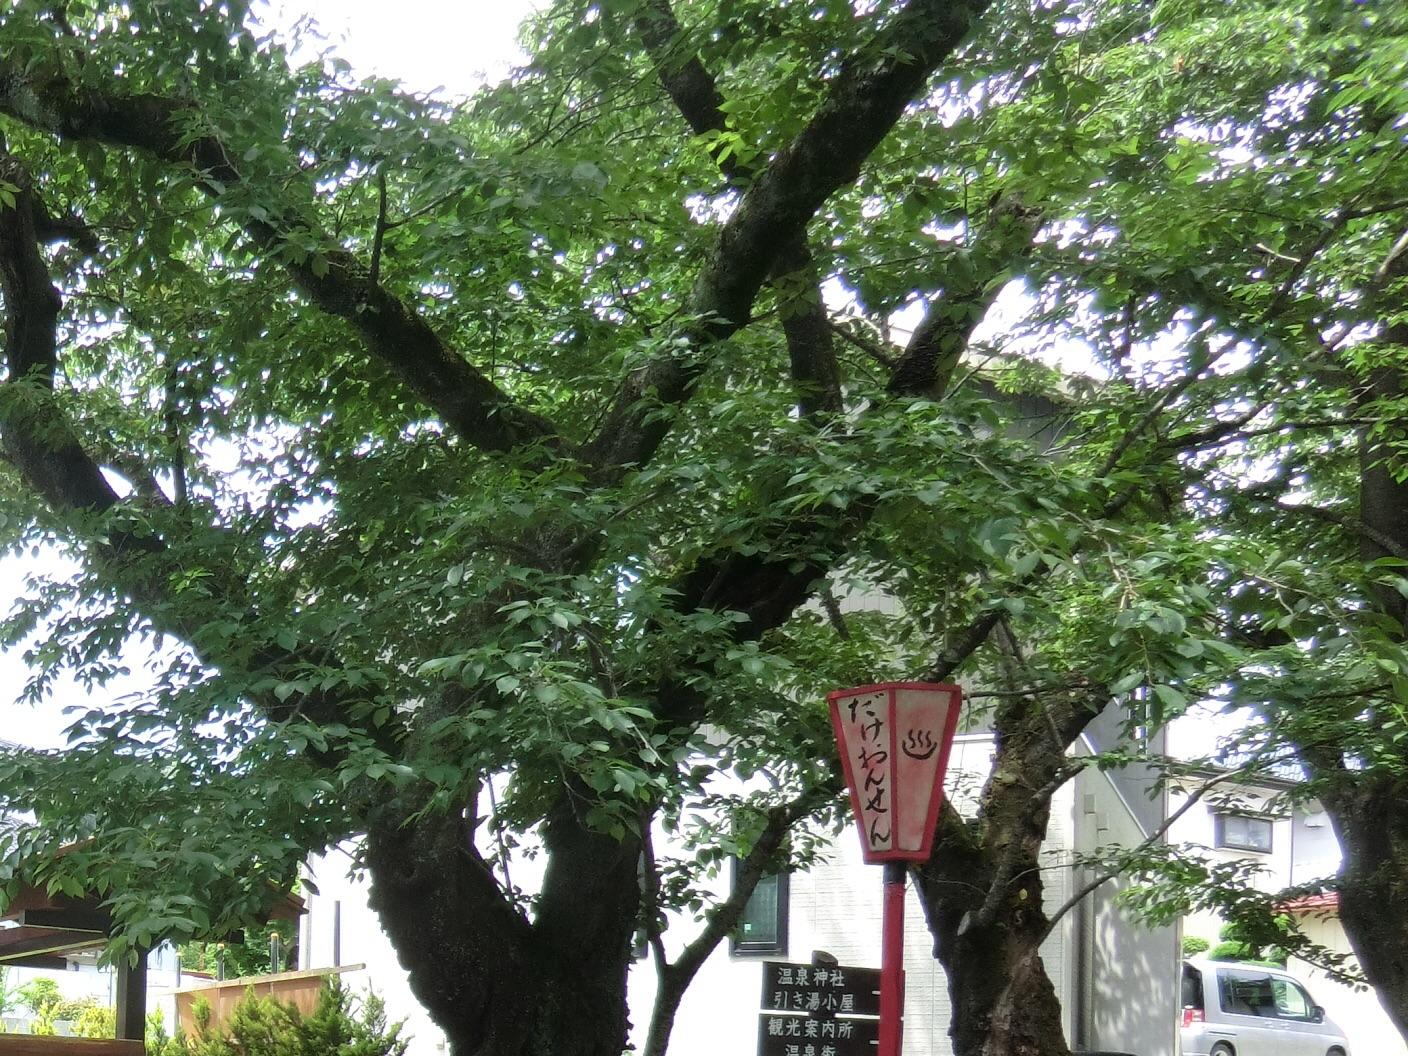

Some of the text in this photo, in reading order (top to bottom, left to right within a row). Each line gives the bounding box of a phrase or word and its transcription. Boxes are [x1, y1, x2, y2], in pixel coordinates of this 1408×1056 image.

[777, 967, 845, 987] 温泉神社
[774, 990, 853, 1012] 引き湯小屋
[768, 1018, 853, 1039] 観光案内所
